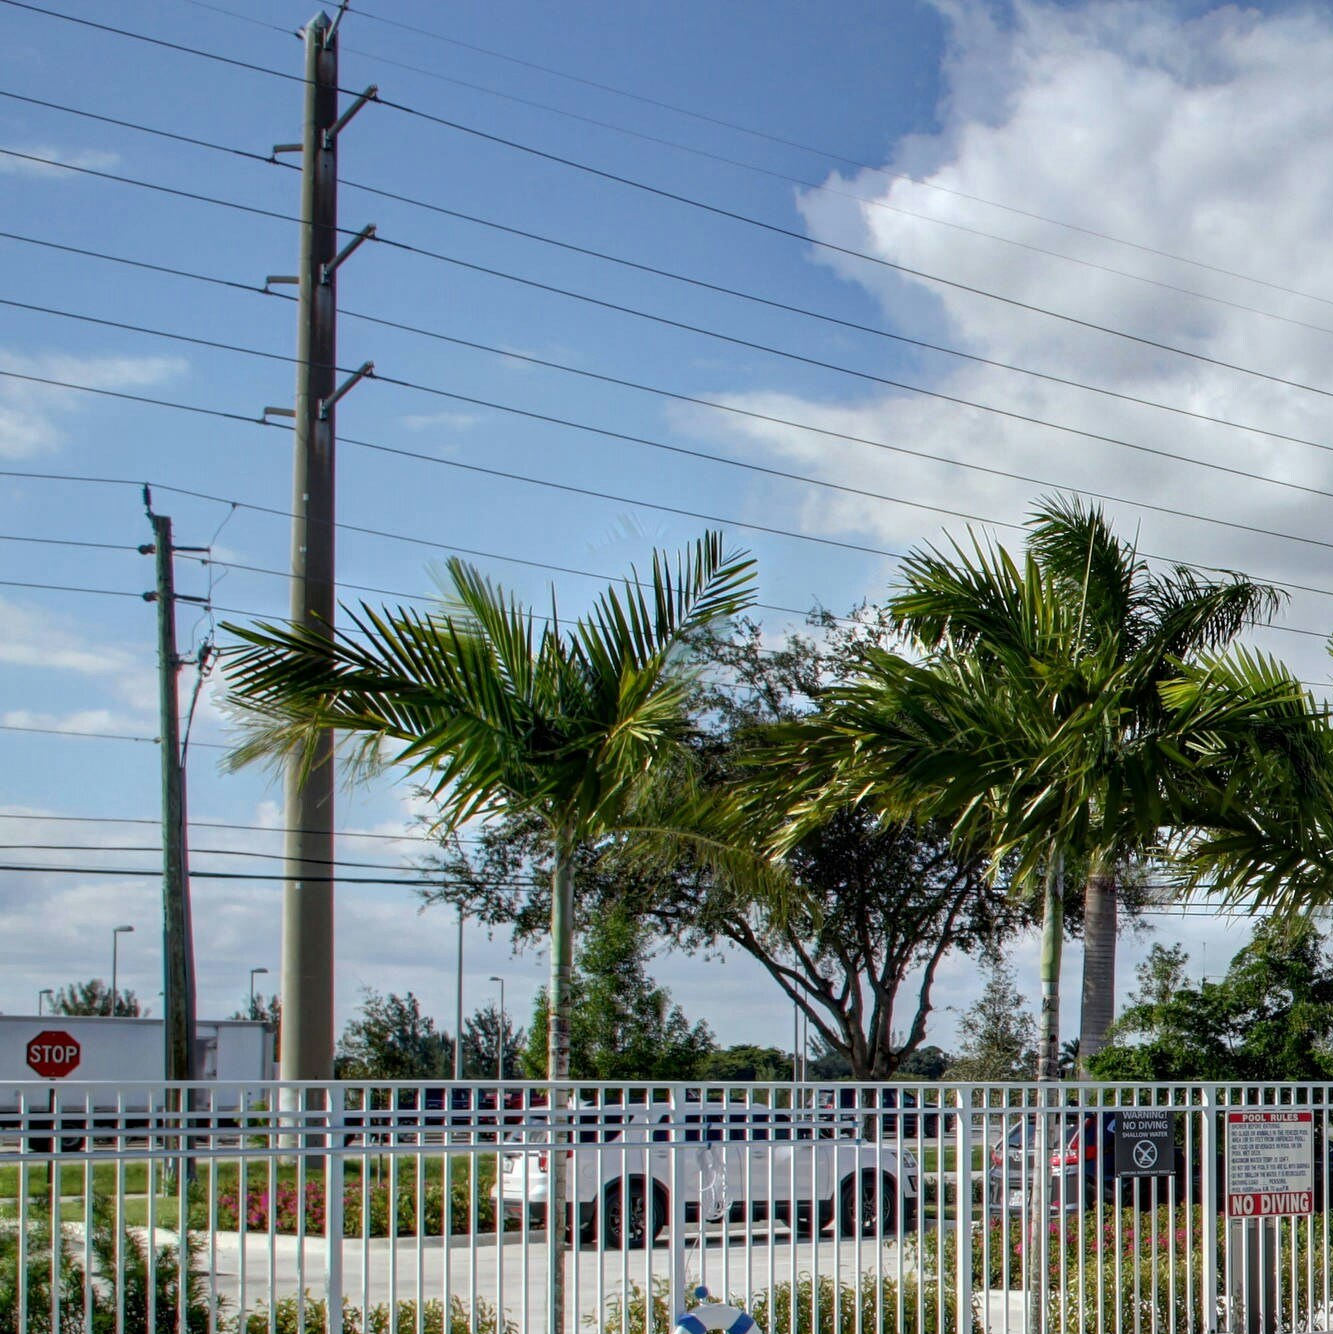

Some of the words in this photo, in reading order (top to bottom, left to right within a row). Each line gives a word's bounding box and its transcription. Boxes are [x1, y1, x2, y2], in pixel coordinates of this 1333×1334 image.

[30, 1045, 78, 1063] STOP
[1122, 1111, 1168, 1119] WARNING!
[1242, 1114, 1266, 1122] POOL
[1270, 1113, 1299, 1121] RULES
[1122, 1121, 1136, 1130] NO
[1138, 1120, 1169, 1130] DIVING
[1232, 1195, 1254, 1215] NO
[1260, 1192, 1310, 1214] DIVING
